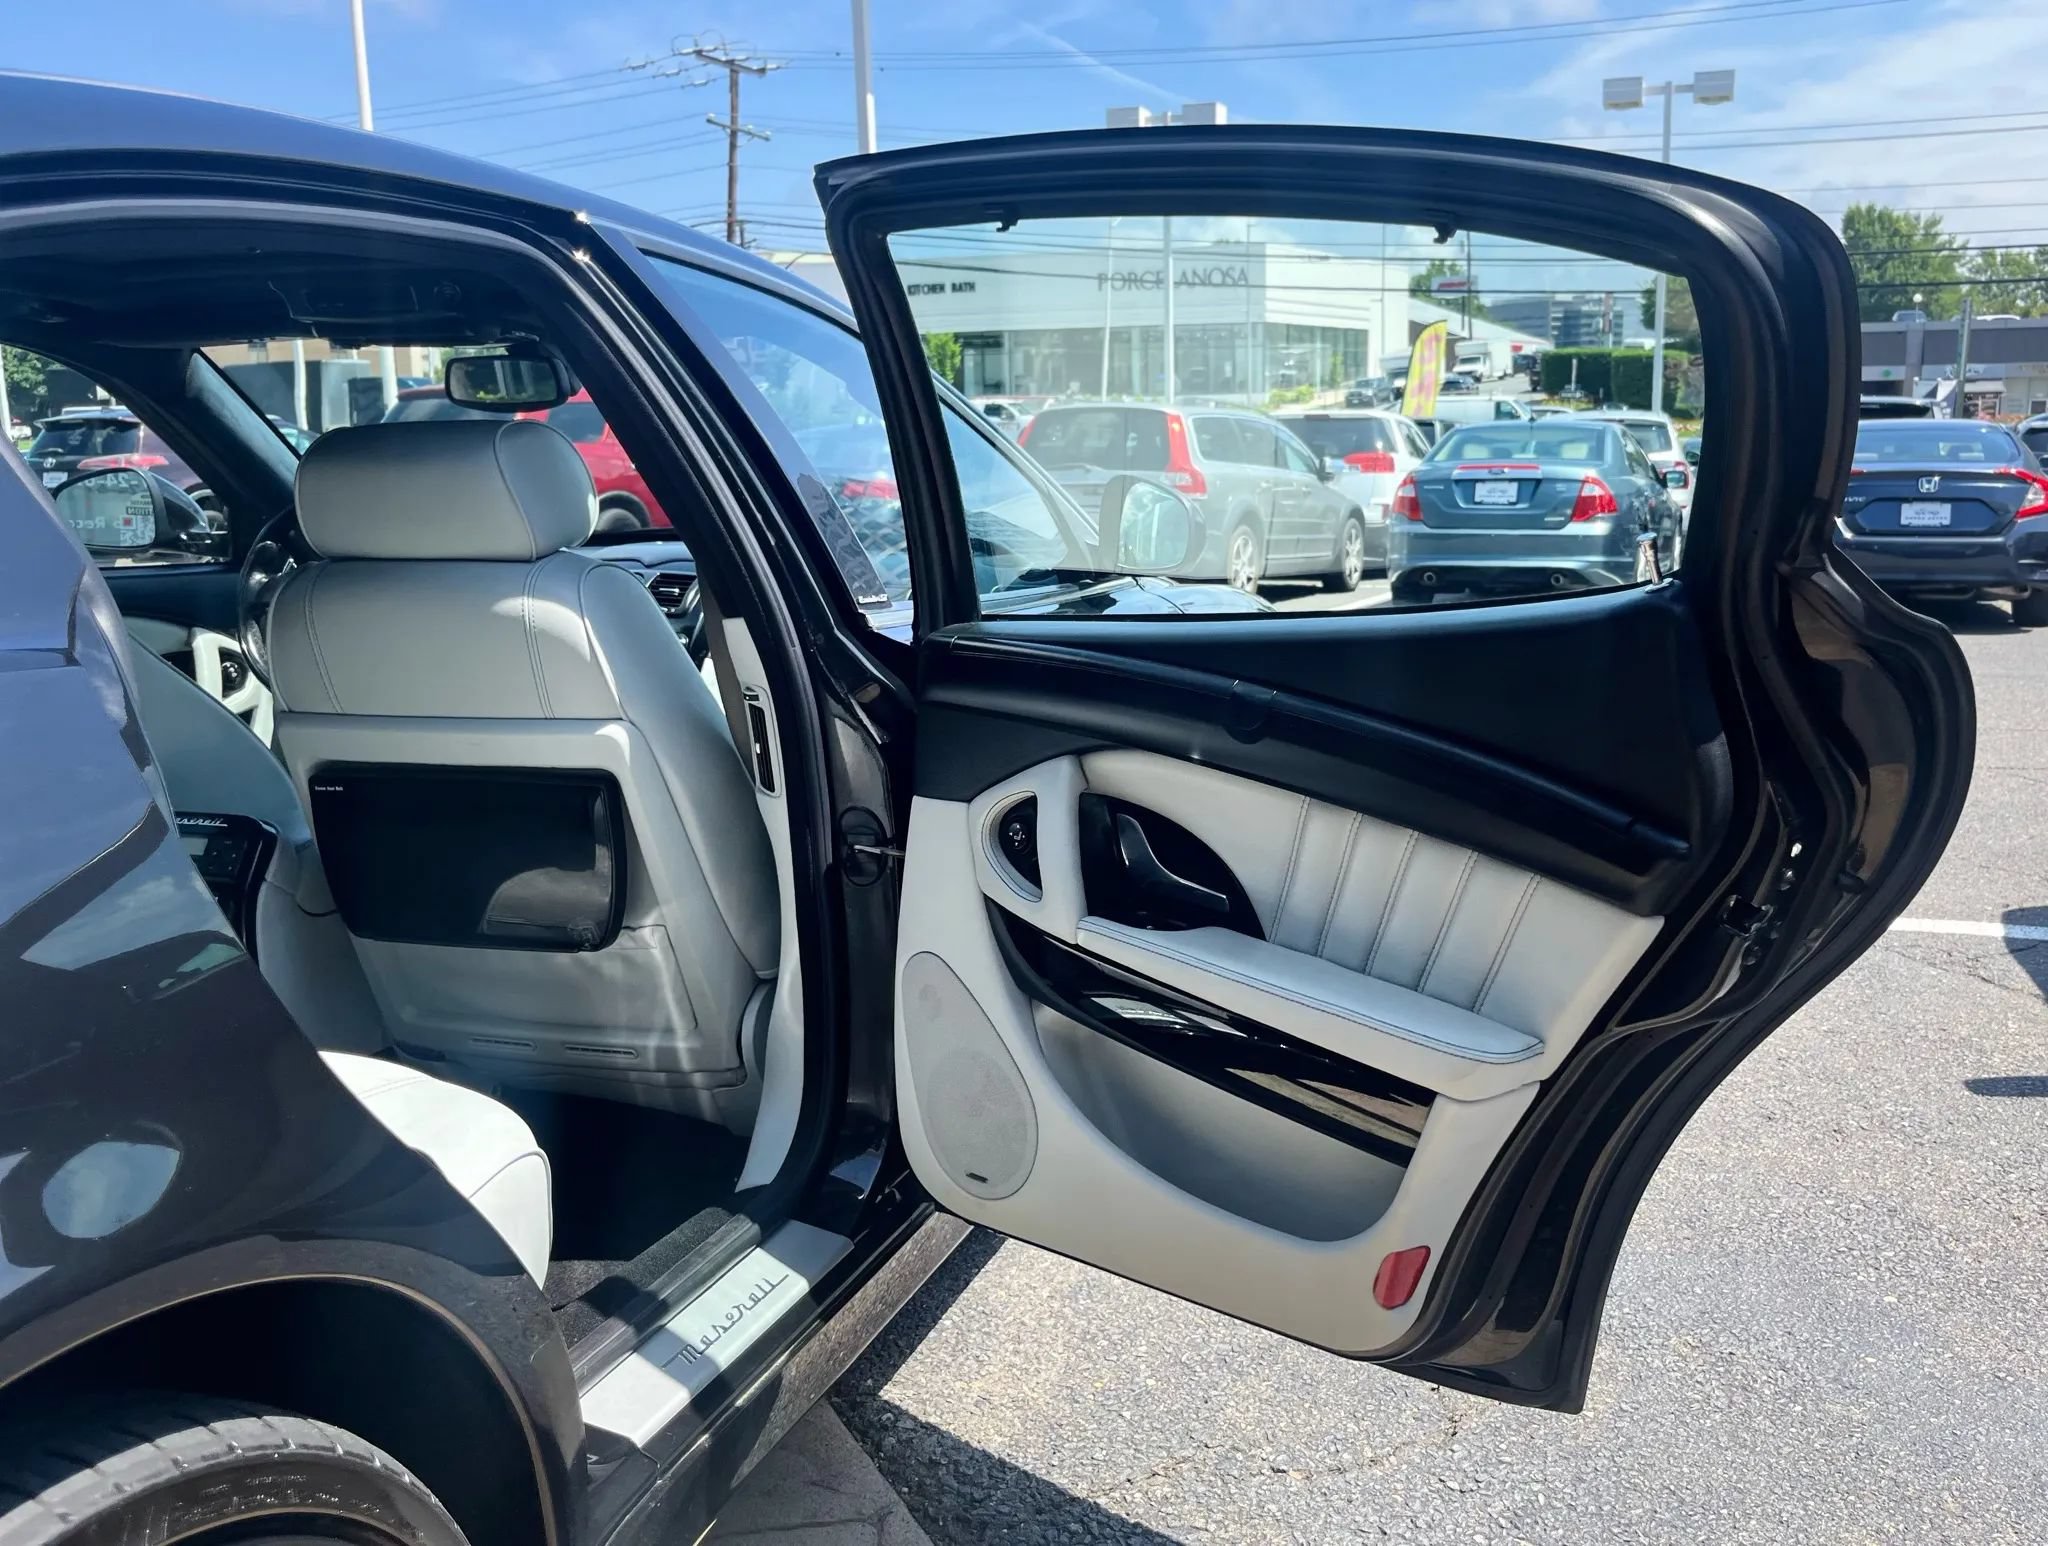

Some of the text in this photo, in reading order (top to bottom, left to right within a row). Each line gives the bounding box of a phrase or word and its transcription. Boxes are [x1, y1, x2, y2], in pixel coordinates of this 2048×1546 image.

[951, 282, 976, 293] BATH
[1097, 266, 1249, 291] PORCEANOSA
[662, 1274, 789, 1370] Maserati
